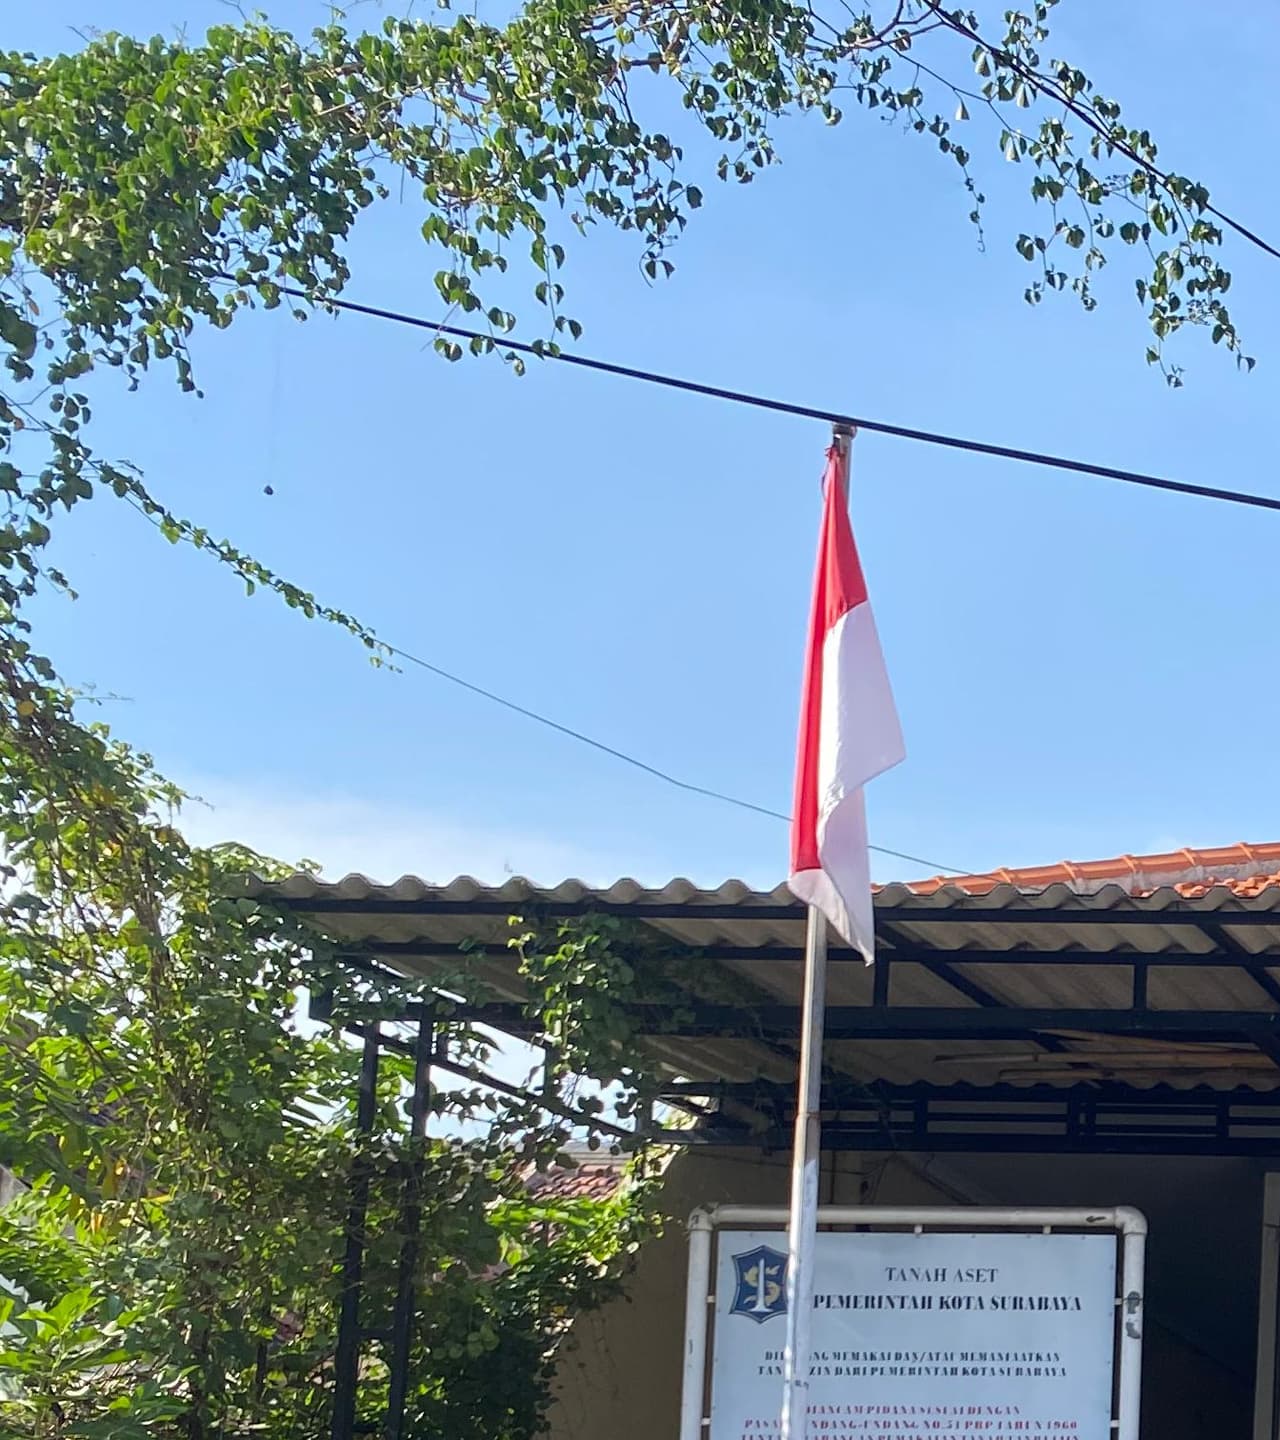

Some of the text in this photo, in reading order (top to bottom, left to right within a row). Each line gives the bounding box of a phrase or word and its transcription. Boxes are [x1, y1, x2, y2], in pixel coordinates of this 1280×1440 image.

[885, 1267, 998, 1283] TANAH ASET
[813, 1294, 1081, 1311] PEMERINTAH KOTA SURABAYA
[808, 1366, 831, 1376] ZIN
[962, 1367, 995, 1377] KOTA
[811, 1420, 919, 1430] NDANG-UNDANG
